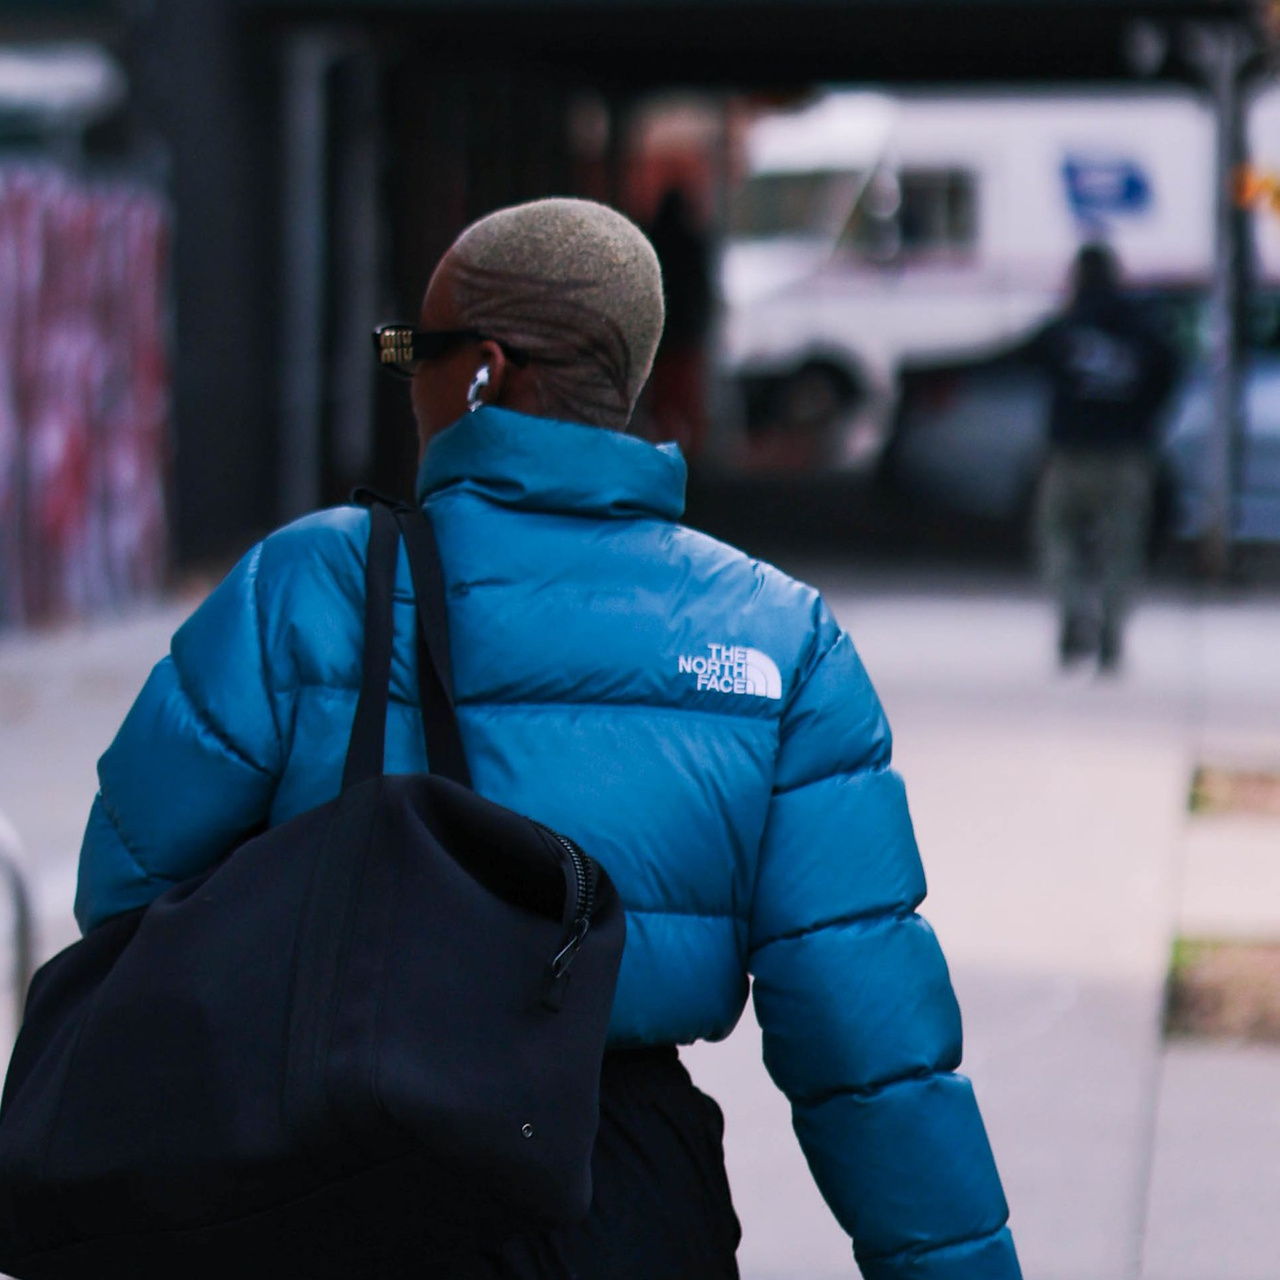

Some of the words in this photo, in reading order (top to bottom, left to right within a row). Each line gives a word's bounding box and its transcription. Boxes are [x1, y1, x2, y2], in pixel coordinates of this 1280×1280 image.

[707, 642, 747, 663] THE
[678, 654, 747, 680] NORTH
[696, 673, 748, 695] FACE
